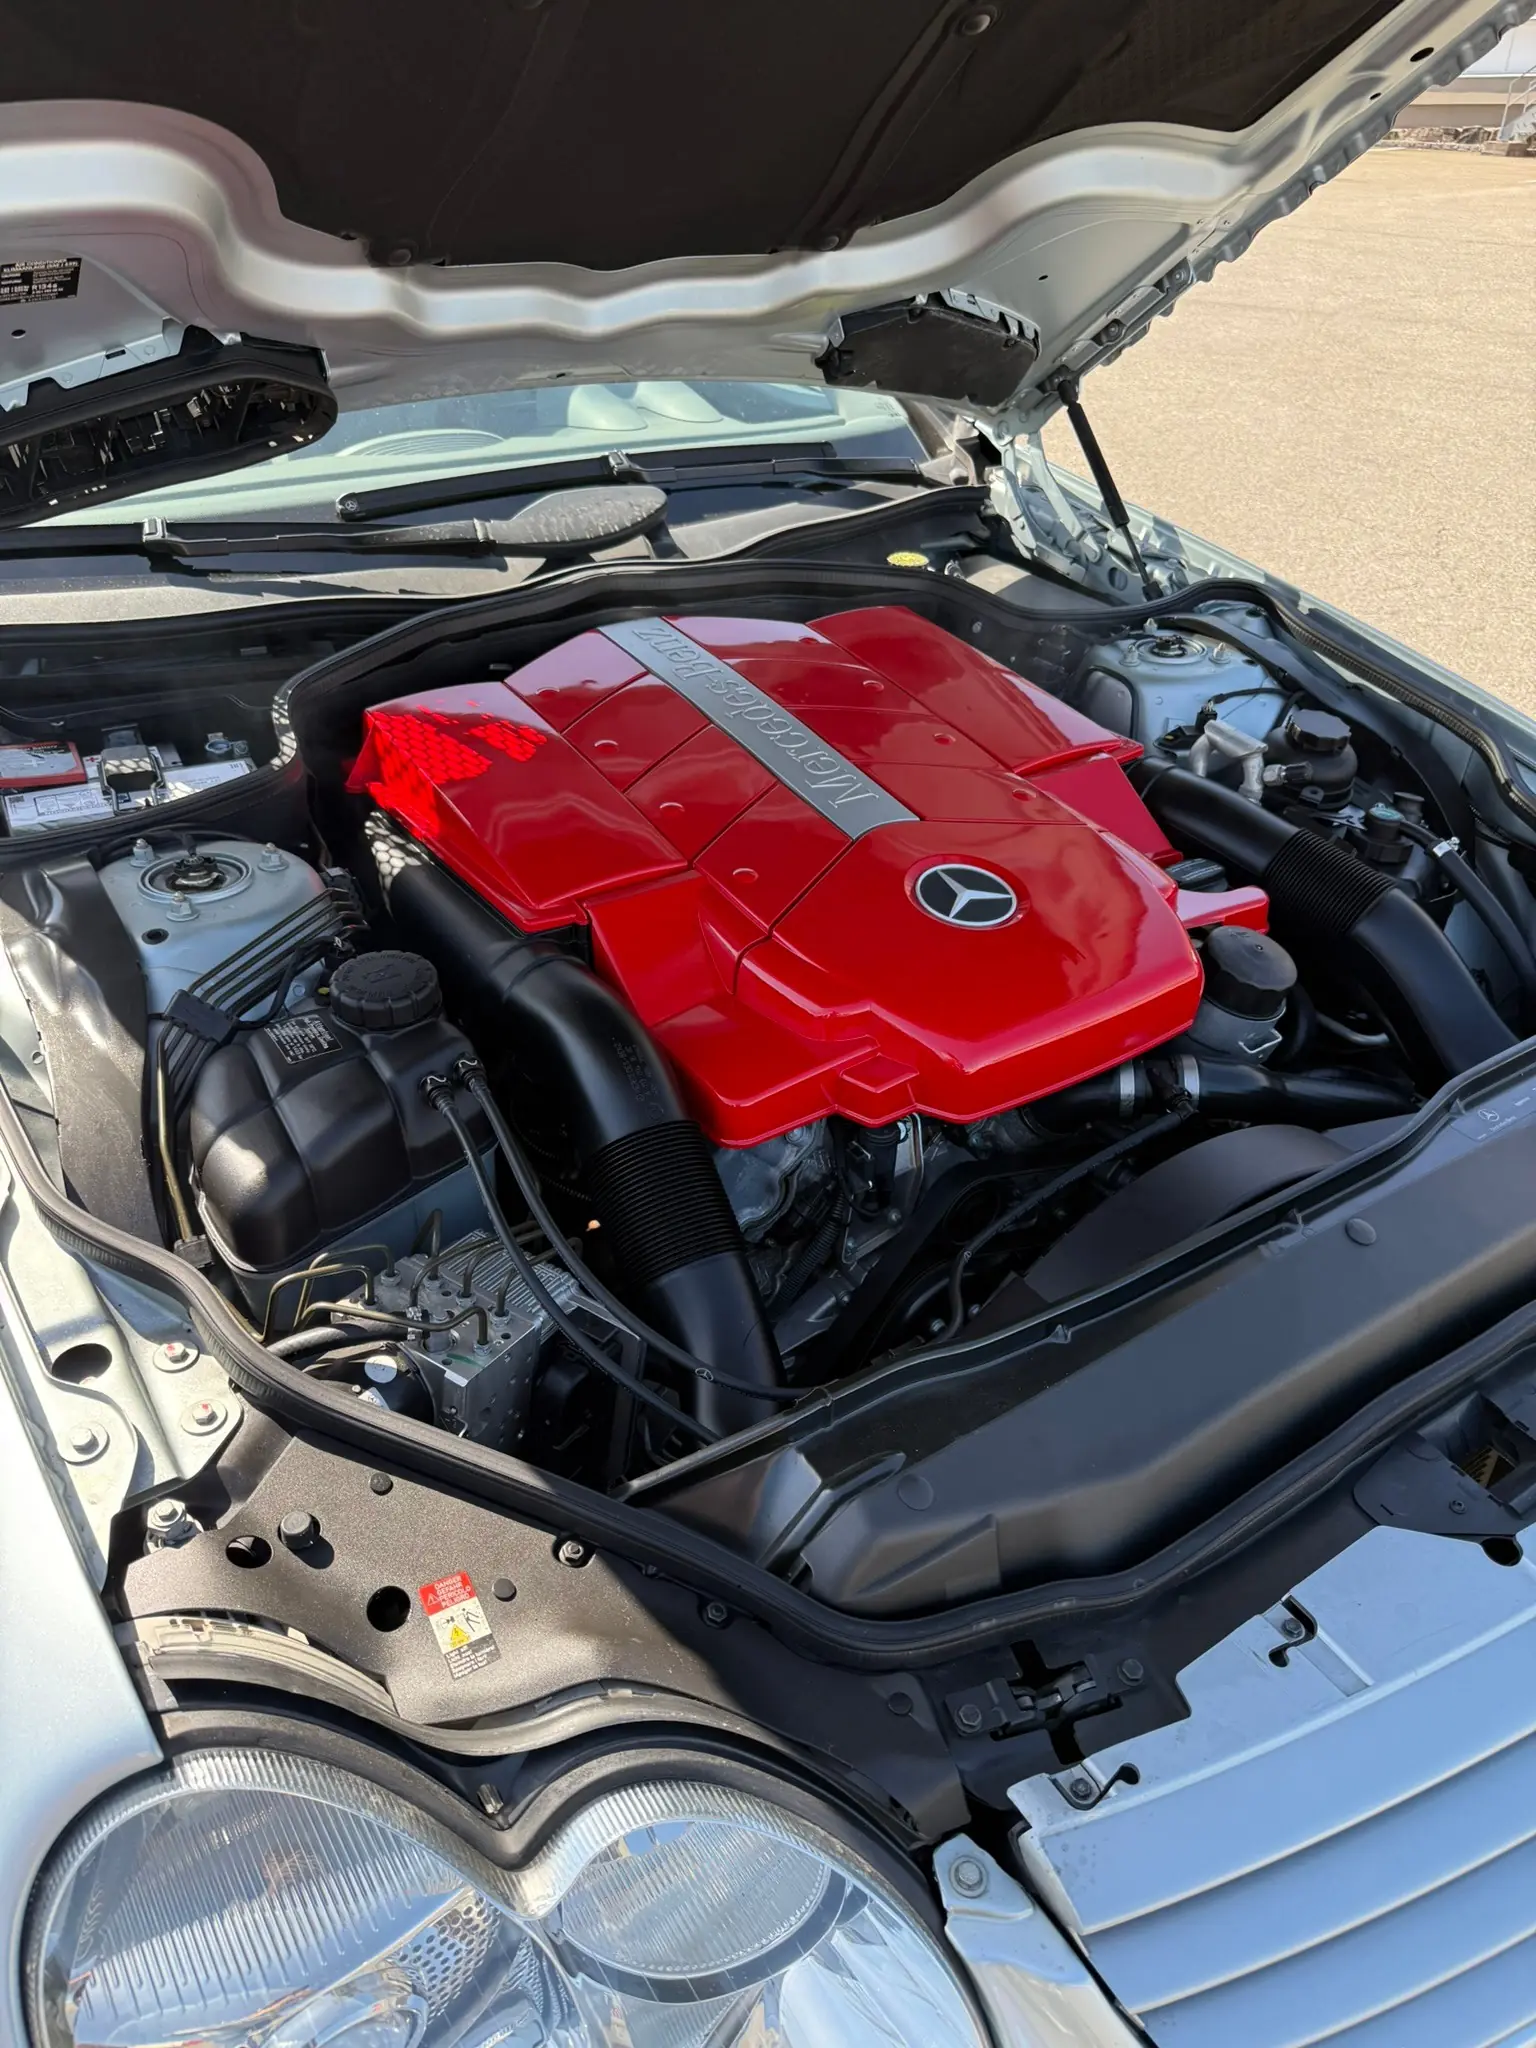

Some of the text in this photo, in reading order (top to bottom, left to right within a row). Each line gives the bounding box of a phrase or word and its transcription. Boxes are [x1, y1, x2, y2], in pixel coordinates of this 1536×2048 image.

[632, 627, 879, 809] Mercedes-Benz
[434, 1575, 462, 1589] DANGER
[437, 1582, 464, 1595] GEFAHR
[439, 1586, 471, 1602] PERICOLO
[441, 1593, 470, 1608] PELIGRO
